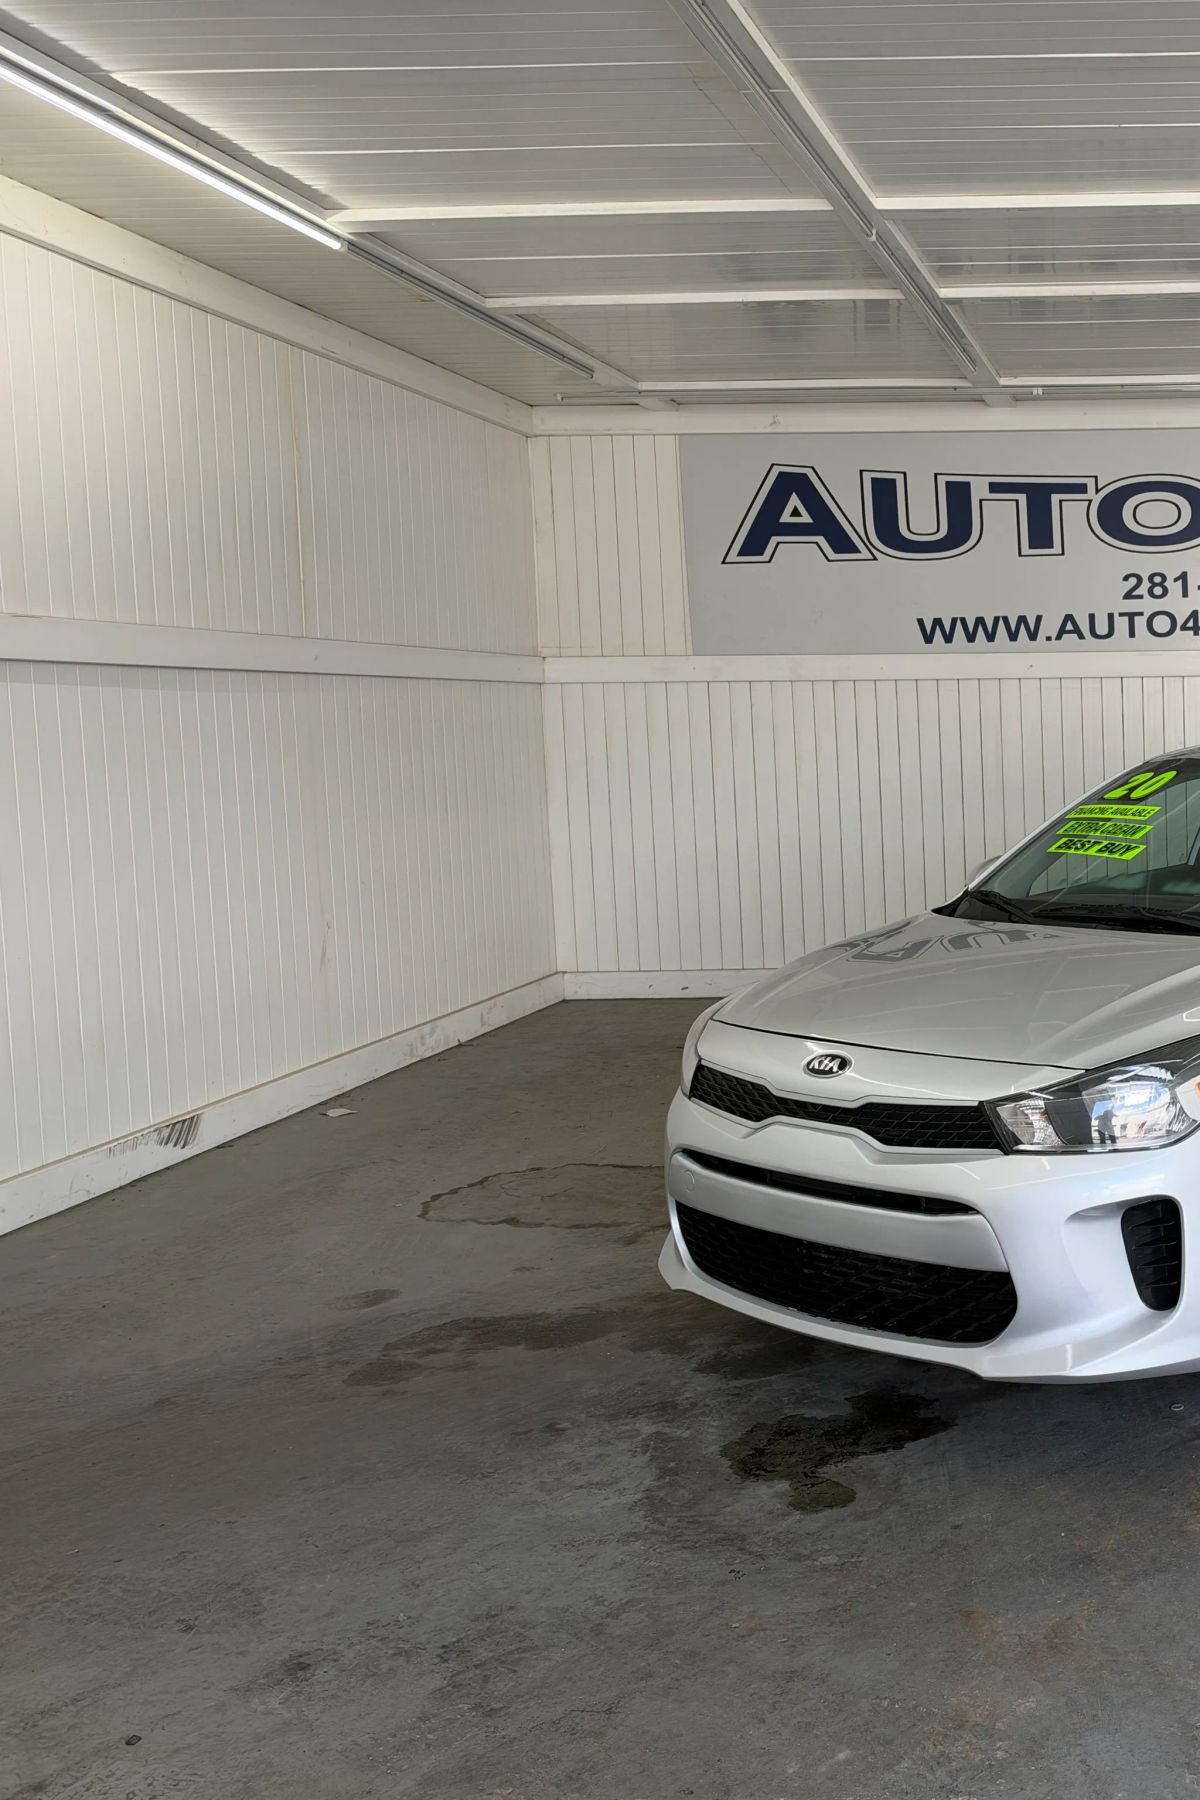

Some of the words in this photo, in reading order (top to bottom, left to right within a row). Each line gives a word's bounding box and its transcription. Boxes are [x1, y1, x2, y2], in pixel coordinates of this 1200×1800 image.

[1103, 770, 1178, 800] 20
[1061, 821, 1105, 835] EXTRA
[1100, 823, 1147, 838] CLEAN
[1054, 838, 1103, 853] BEST
[1095, 841, 1141, 857] BUY
[808, 1056, 842, 1073] KIA
